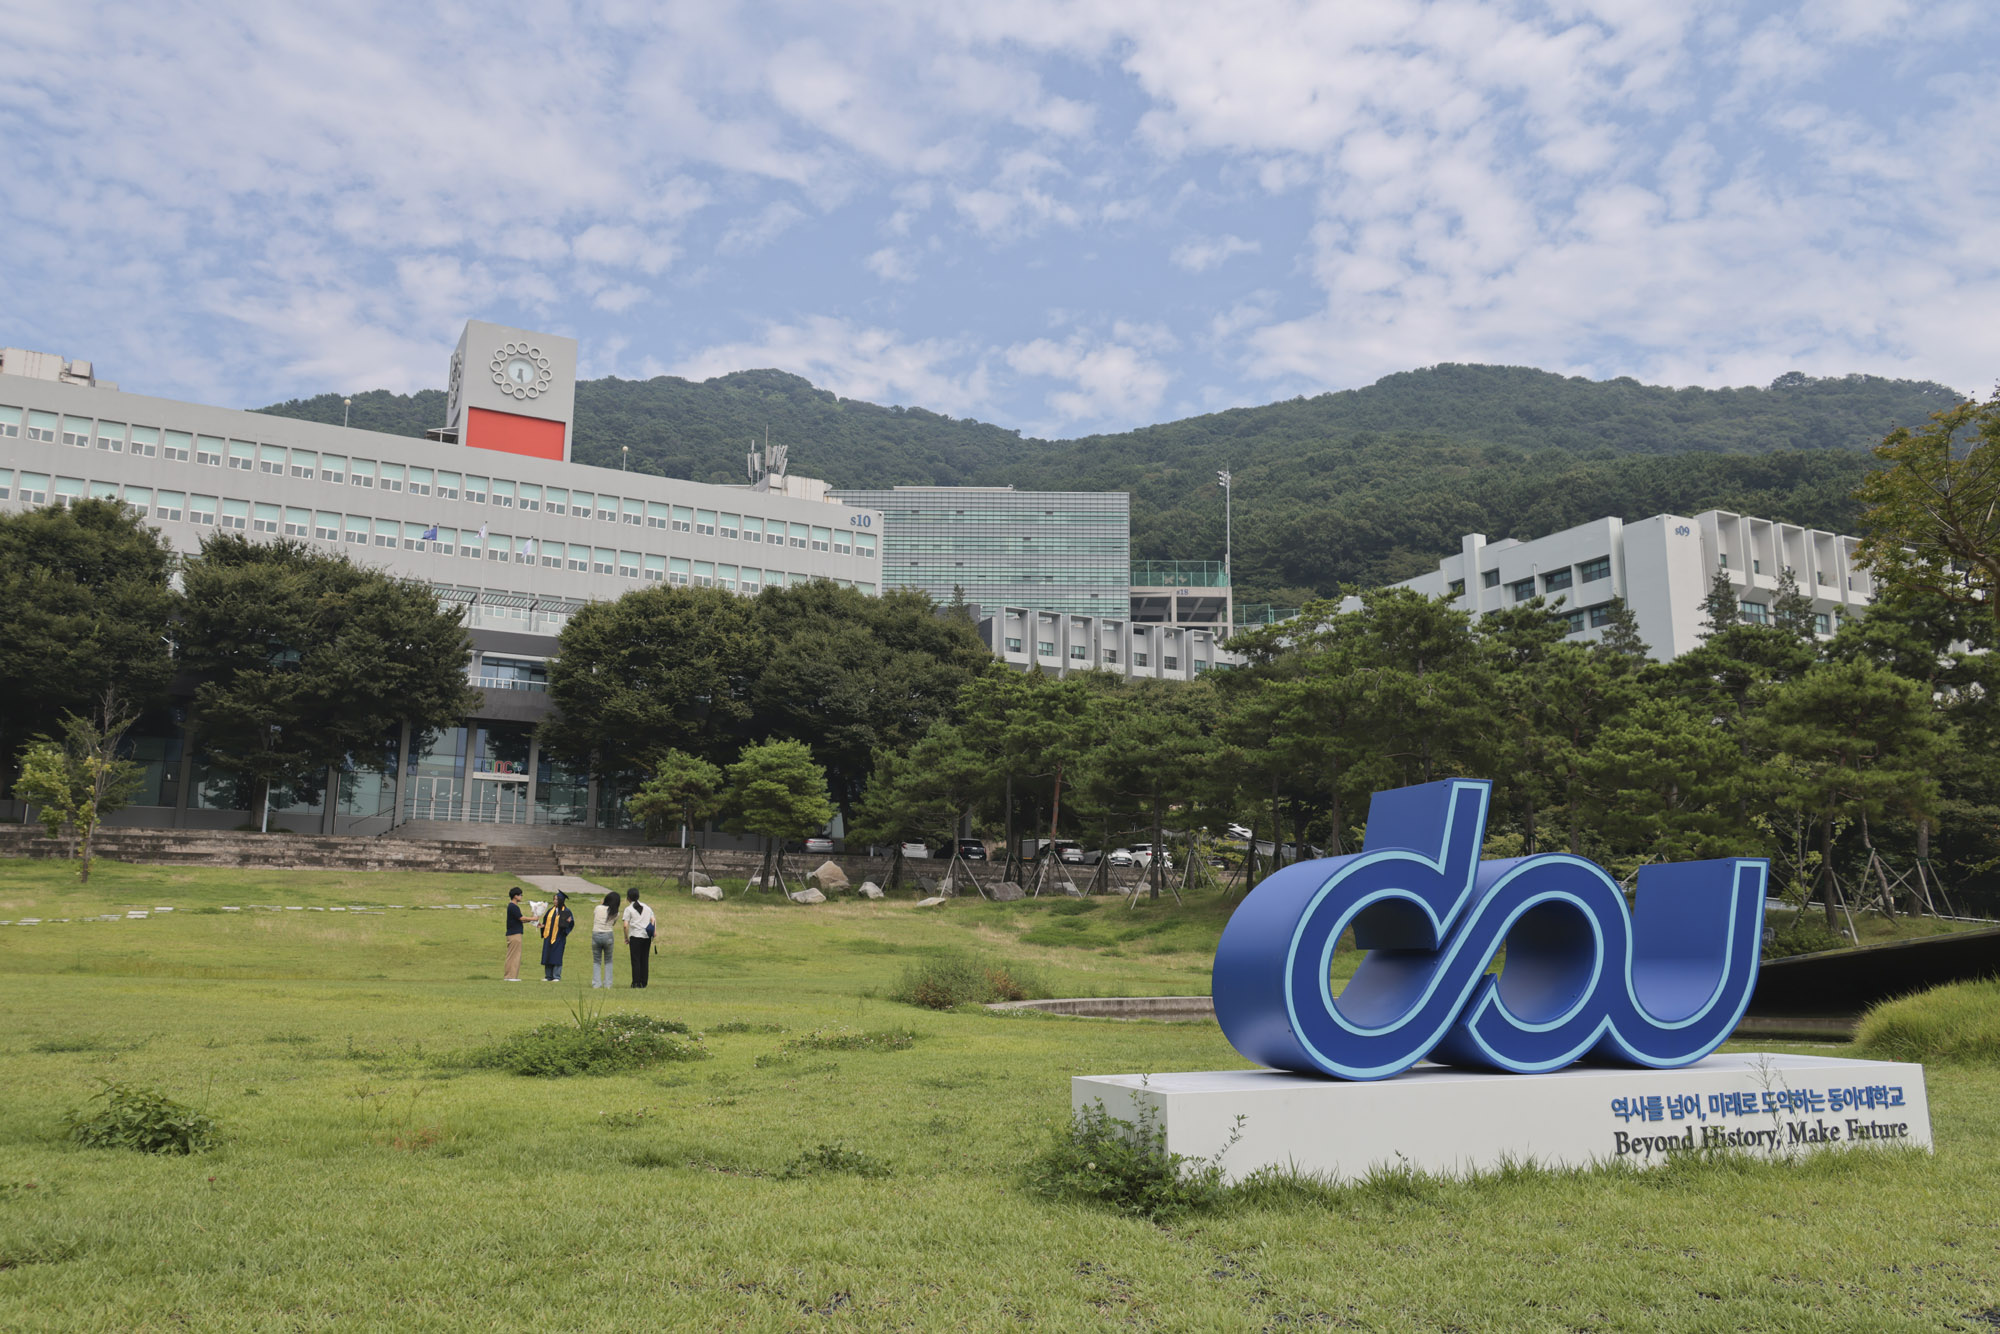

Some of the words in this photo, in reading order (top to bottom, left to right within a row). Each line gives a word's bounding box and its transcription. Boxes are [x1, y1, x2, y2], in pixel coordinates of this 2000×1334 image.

[850, 514, 871, 528] s10
[1611, 1096, 1664, 1123] 역사를
[1667, 1093, 1707, 1122] 넘어,
[1708, 1091, 1760, 1118] 미래로
[1762, 1088, 1825, 1114] 도약하는
[1828, 1085, 1906, 1112] 동아대학교
[1614, 1125, 1695, 1159] Beyond
[1700, 1122, 1781, 1154] History,
[1786, 1118, 1841, 1145] Make
[1845, 1117, 1909, 1142] Future
